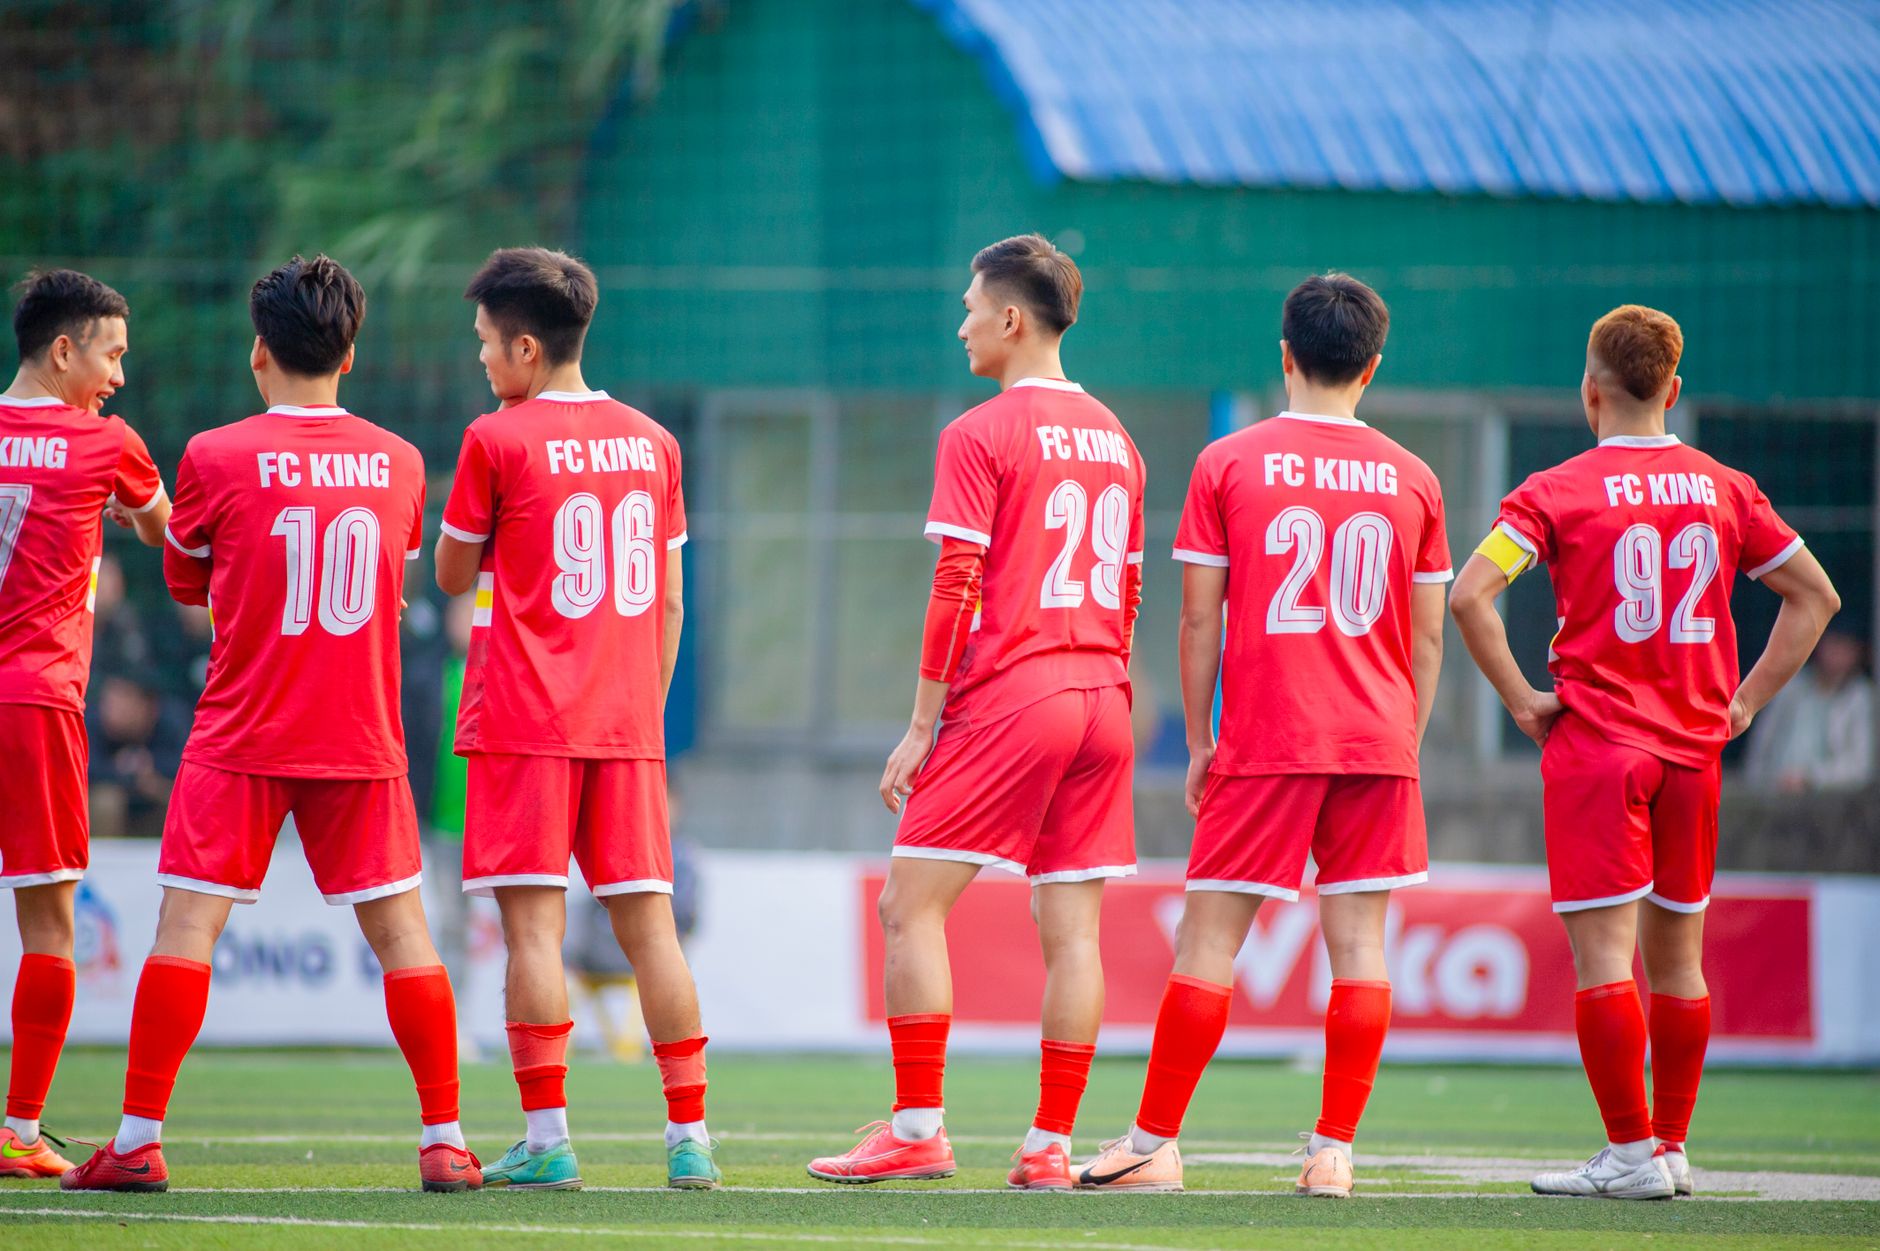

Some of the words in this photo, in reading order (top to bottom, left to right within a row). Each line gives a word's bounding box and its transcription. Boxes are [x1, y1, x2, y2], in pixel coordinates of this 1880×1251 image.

[257, 452, 302, 488] FC
[309, 452, 390, 488] KING
[546, 439, 585, 475] FC
[590, 435, 657, 473] KING
[1036, 425, 1072, 460] FC
[1073, 428, 1130, 469] KING
[1264, 453, 1305, 488] FC
[1314, 457, 1398, 496] KING
[1604, 474, 1643, 507] FC
[1648, 473, 1717, 507] KING
[271, 507, 380, 636] 10
[551, 490, 657, 618] 96
[1040, 479, 1130, 609] 29
[1265, 506, 1393, 637] 20
[1614, 523, 1719, 643] 92
